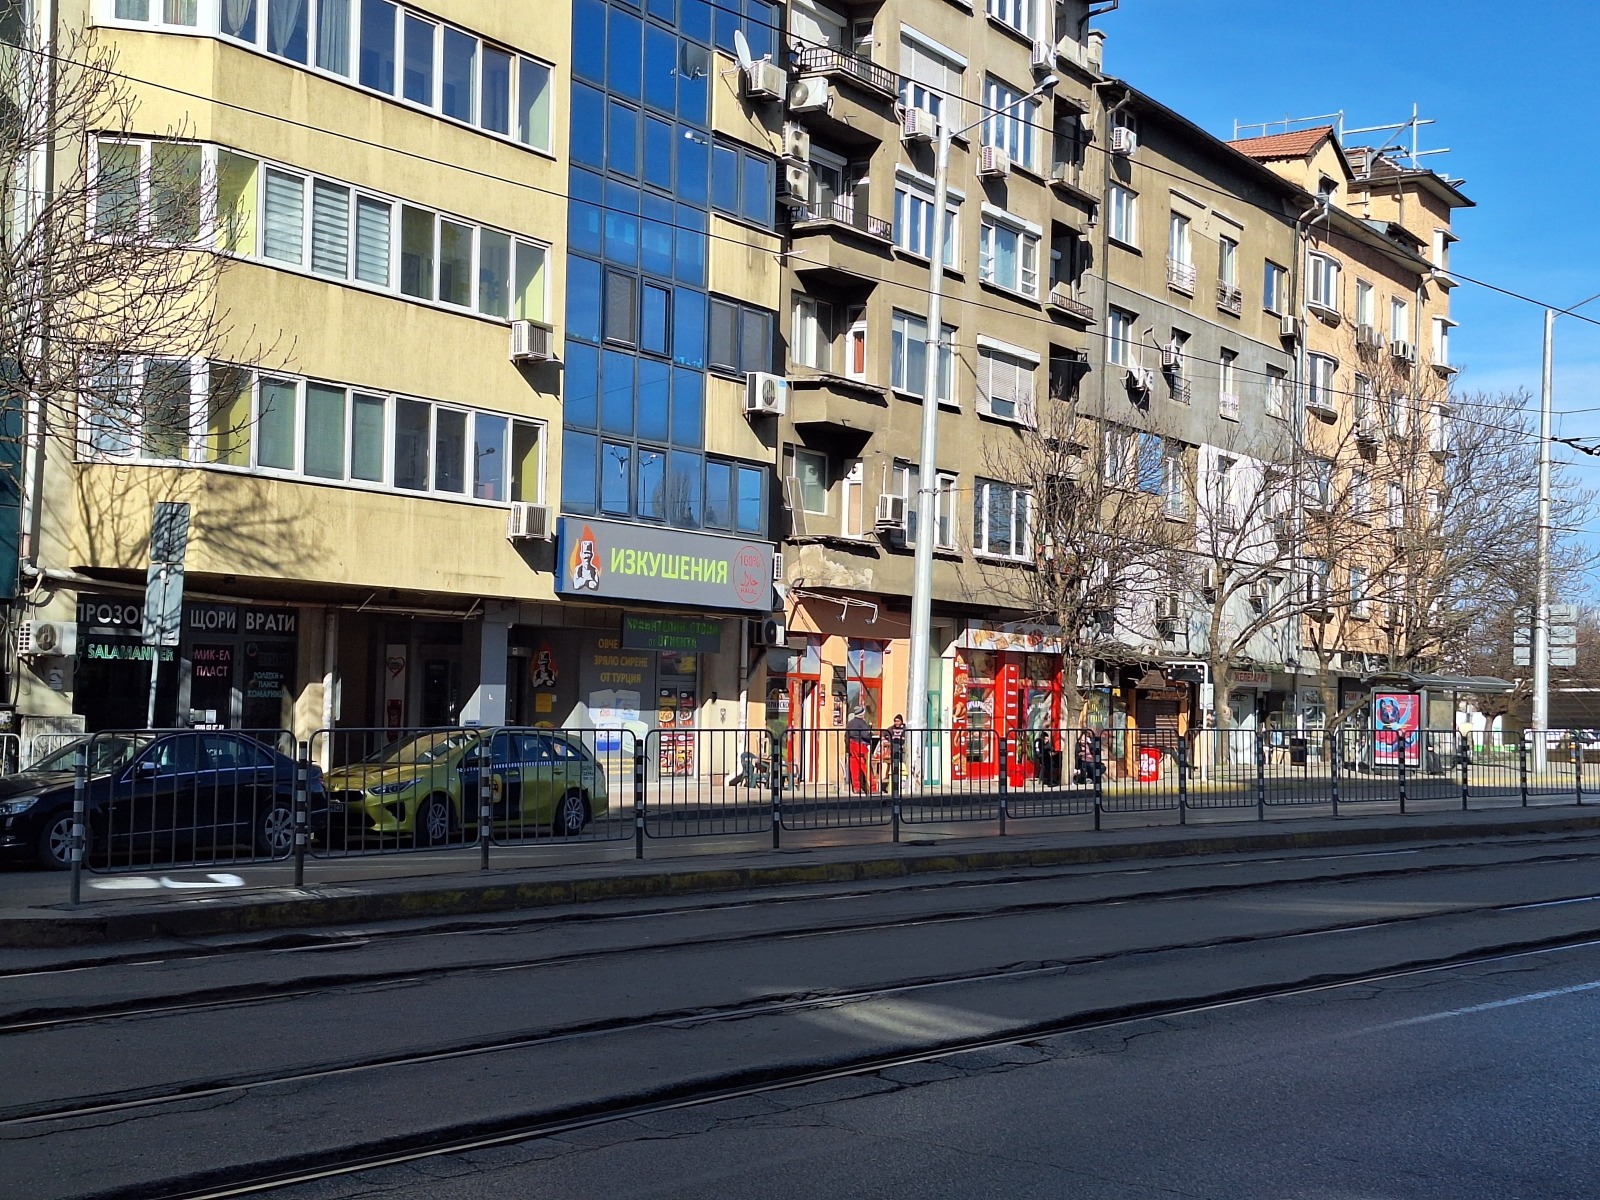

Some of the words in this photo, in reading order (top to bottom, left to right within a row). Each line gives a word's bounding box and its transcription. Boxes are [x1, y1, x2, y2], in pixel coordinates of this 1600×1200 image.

[611, 547, 728, 584] ИЗКУШЕНИЯ
[740, 554, 761, 567] 100%
[77, 603, 144, 624] ПРОЗО
[190, 609, 236, 630] ЩОРИ
[245, 612, 295, 631] ВРАТИ
[598, 638, 619, 649] ОВЧЕ
[194, 649, 230, 661] МИК-ЕЛ
[594, 655, 619, 666] ЗРЯЛО
[620, 656, 648, 667] СИРЕНЕ
[196, 665, 228, 677] ПЛАСТ
[600, 672, 611, 682] ОТ
[612, 672, 641, 685] ТУРЦИЯ
